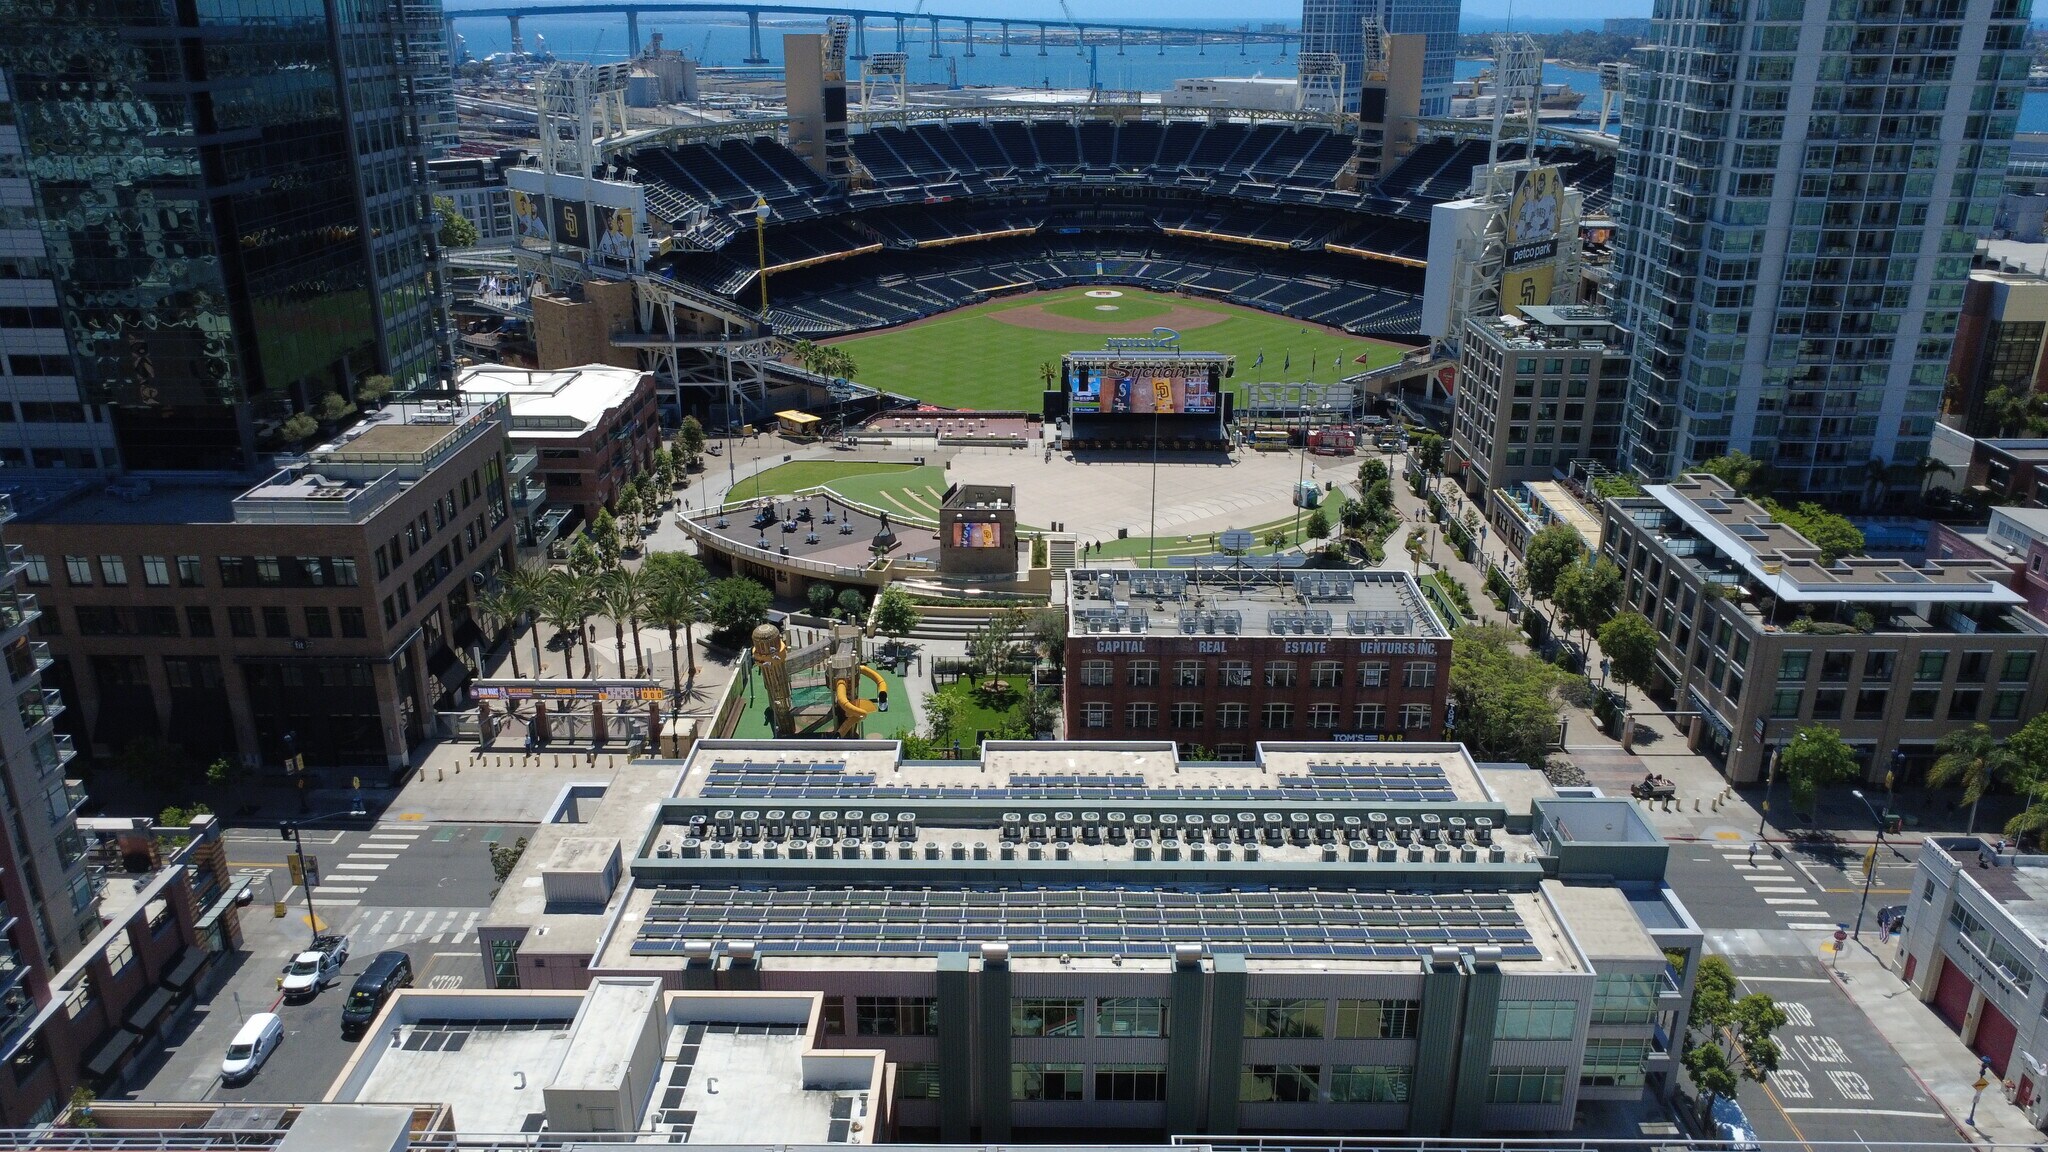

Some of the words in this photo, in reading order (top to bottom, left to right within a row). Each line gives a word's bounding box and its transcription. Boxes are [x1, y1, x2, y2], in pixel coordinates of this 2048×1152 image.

[564, 206, 578, 238] SD
[1514, 247, 1534, 263] petco
[1534, 243, 1551, 258] park
[1107, 361, 1191, 385] Sycuan
[1097, 641, 1145, 653] CAPITAL
[1199, 641, 1227, 653] REAL
[1285, 641, 1326, 654] ESTATE
[1418, 642, 1437, 655] INC.
[1333, 734, 1364, 742] TOM'S
[1379, 734, 1403, 742] BAR
[386, 966, 407, 993] Geek
[428, 975, 463, 989] STOP
[1795, 1035, 1852, 1063] CLEAR
[1767, 1069, 1814, 1098] KEEP
[1825, 1070, 1875, 1100] KEEP
